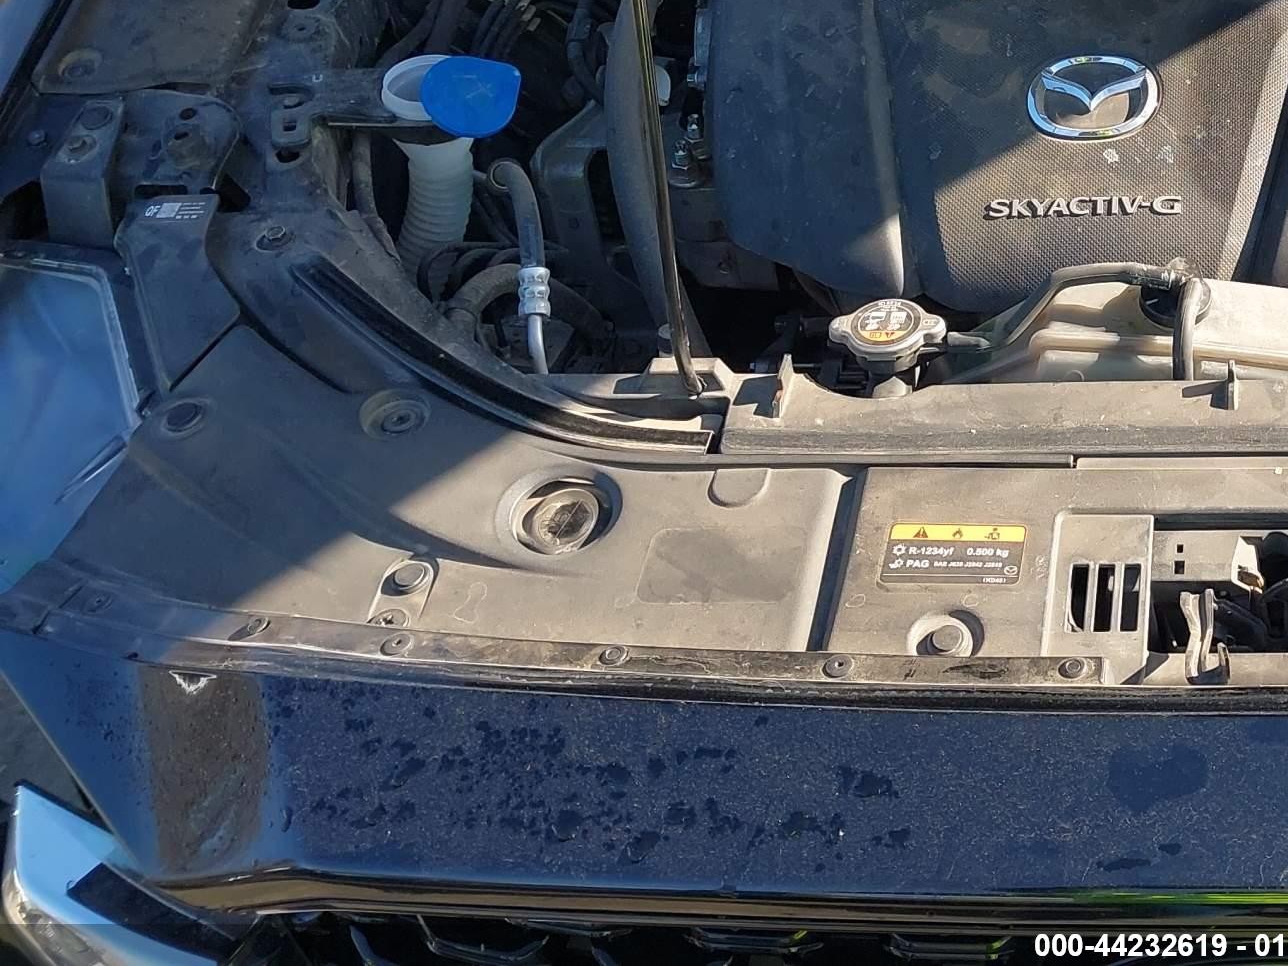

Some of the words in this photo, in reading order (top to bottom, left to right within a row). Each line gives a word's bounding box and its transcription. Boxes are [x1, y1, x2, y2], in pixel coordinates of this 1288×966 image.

[985, 195, 1182, 219] SKYACTIV-G
[908, 546, 955, 558] R-1234yf
[966, 547, 994, 556] 0.500
[995, 548, 1010, 558] kg
[906, 559, 930, 568] PAG
